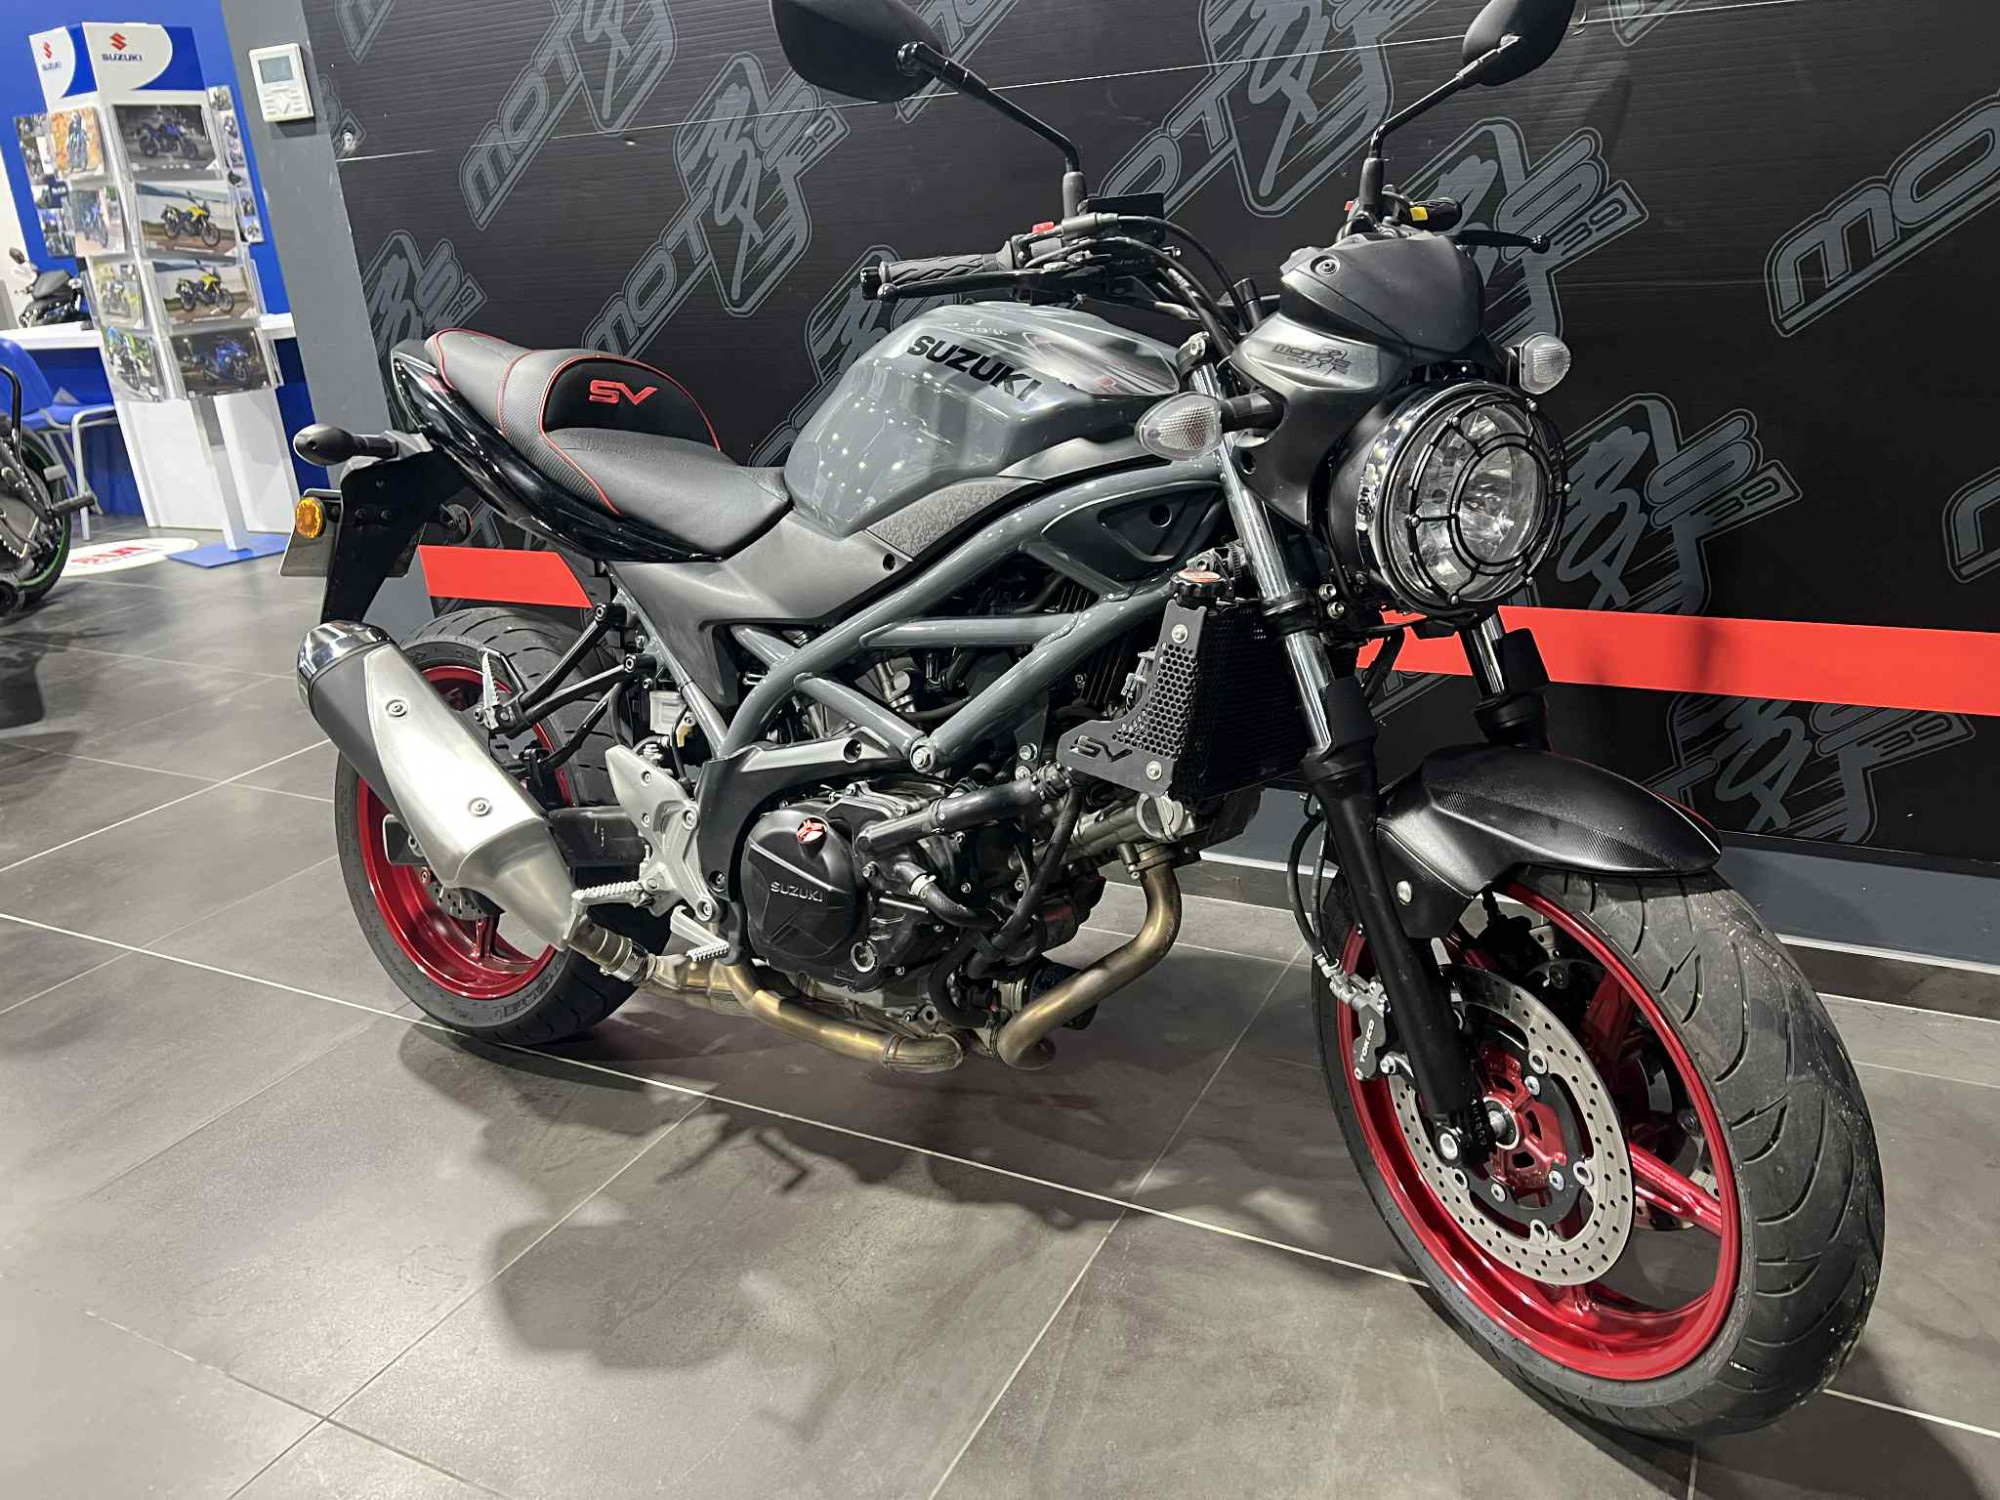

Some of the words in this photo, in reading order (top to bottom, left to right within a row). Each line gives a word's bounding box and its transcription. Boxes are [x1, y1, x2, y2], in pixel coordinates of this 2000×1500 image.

[101, 53, 143, 62] SUZUKI
[907, 335, 1042, 401] SUZUKI
[588, 379, 658, 405] SV
[1069, 735, 1133, 763] SV
[770, 881, 824, 903] SUZUKI
[1359, 1017, 1375, 1064] TOKICO
